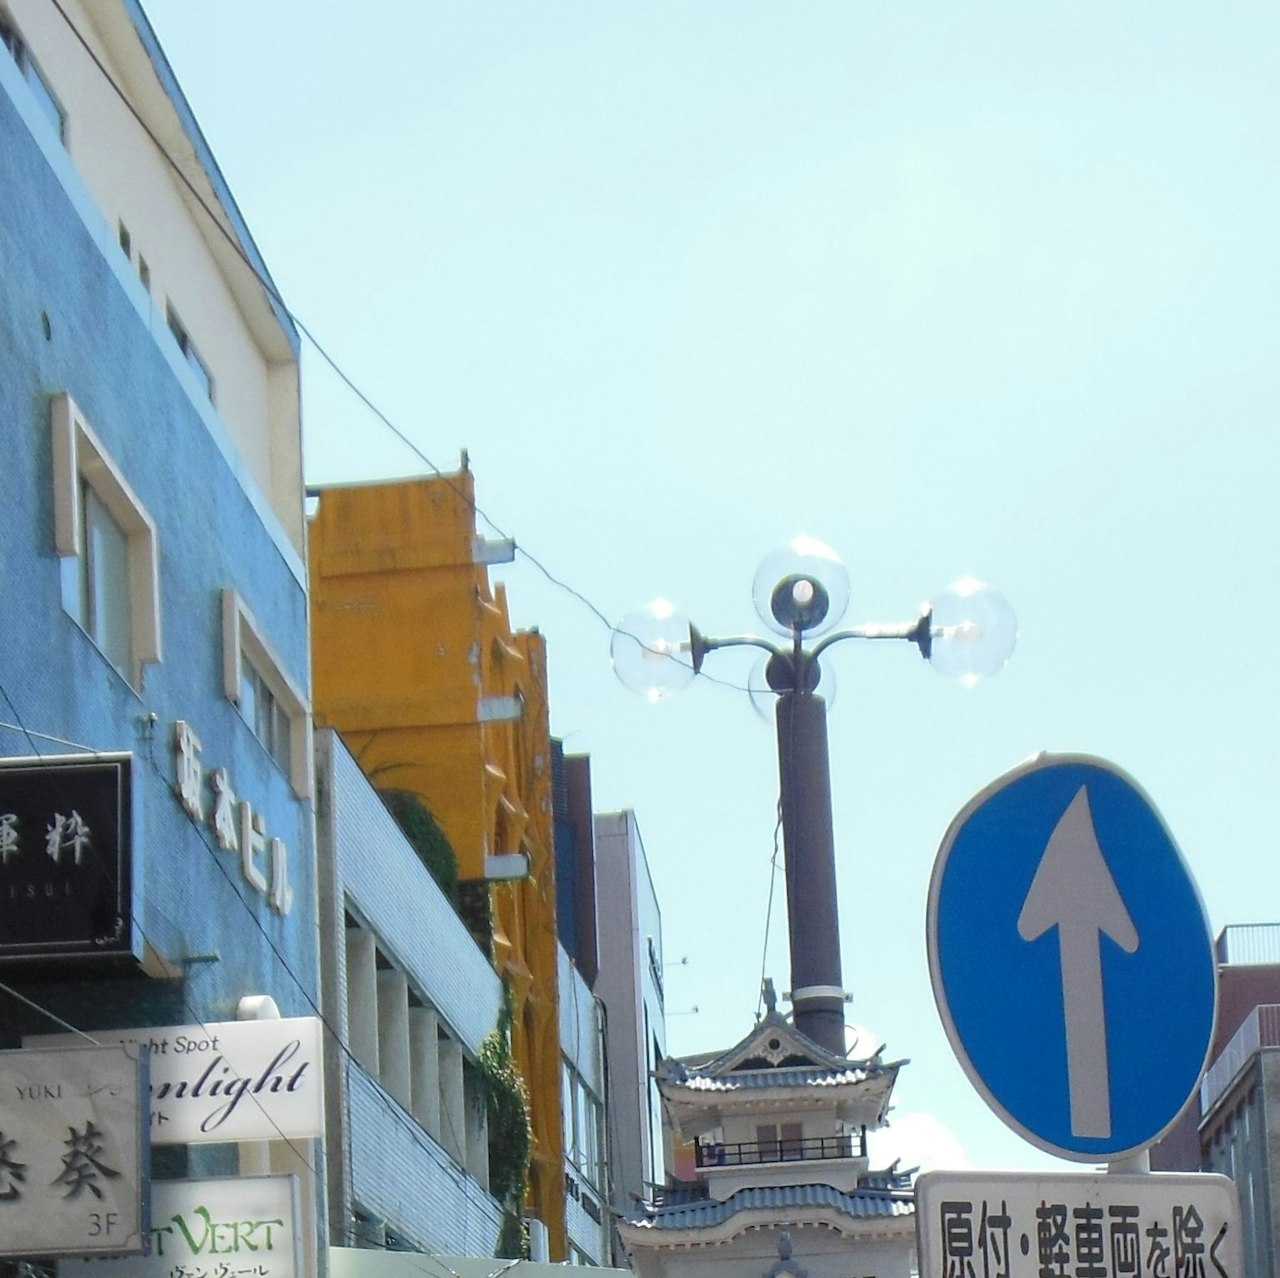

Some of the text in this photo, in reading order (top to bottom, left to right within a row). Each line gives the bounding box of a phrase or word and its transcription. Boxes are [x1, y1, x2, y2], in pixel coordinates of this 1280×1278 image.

[173, 1036, 220, 1056] Spot
[16, 1085, 62, 1100] YUKI
[87, 1213, 119, 1236] 3F
[170, 1205, 284, 1256] VERT
